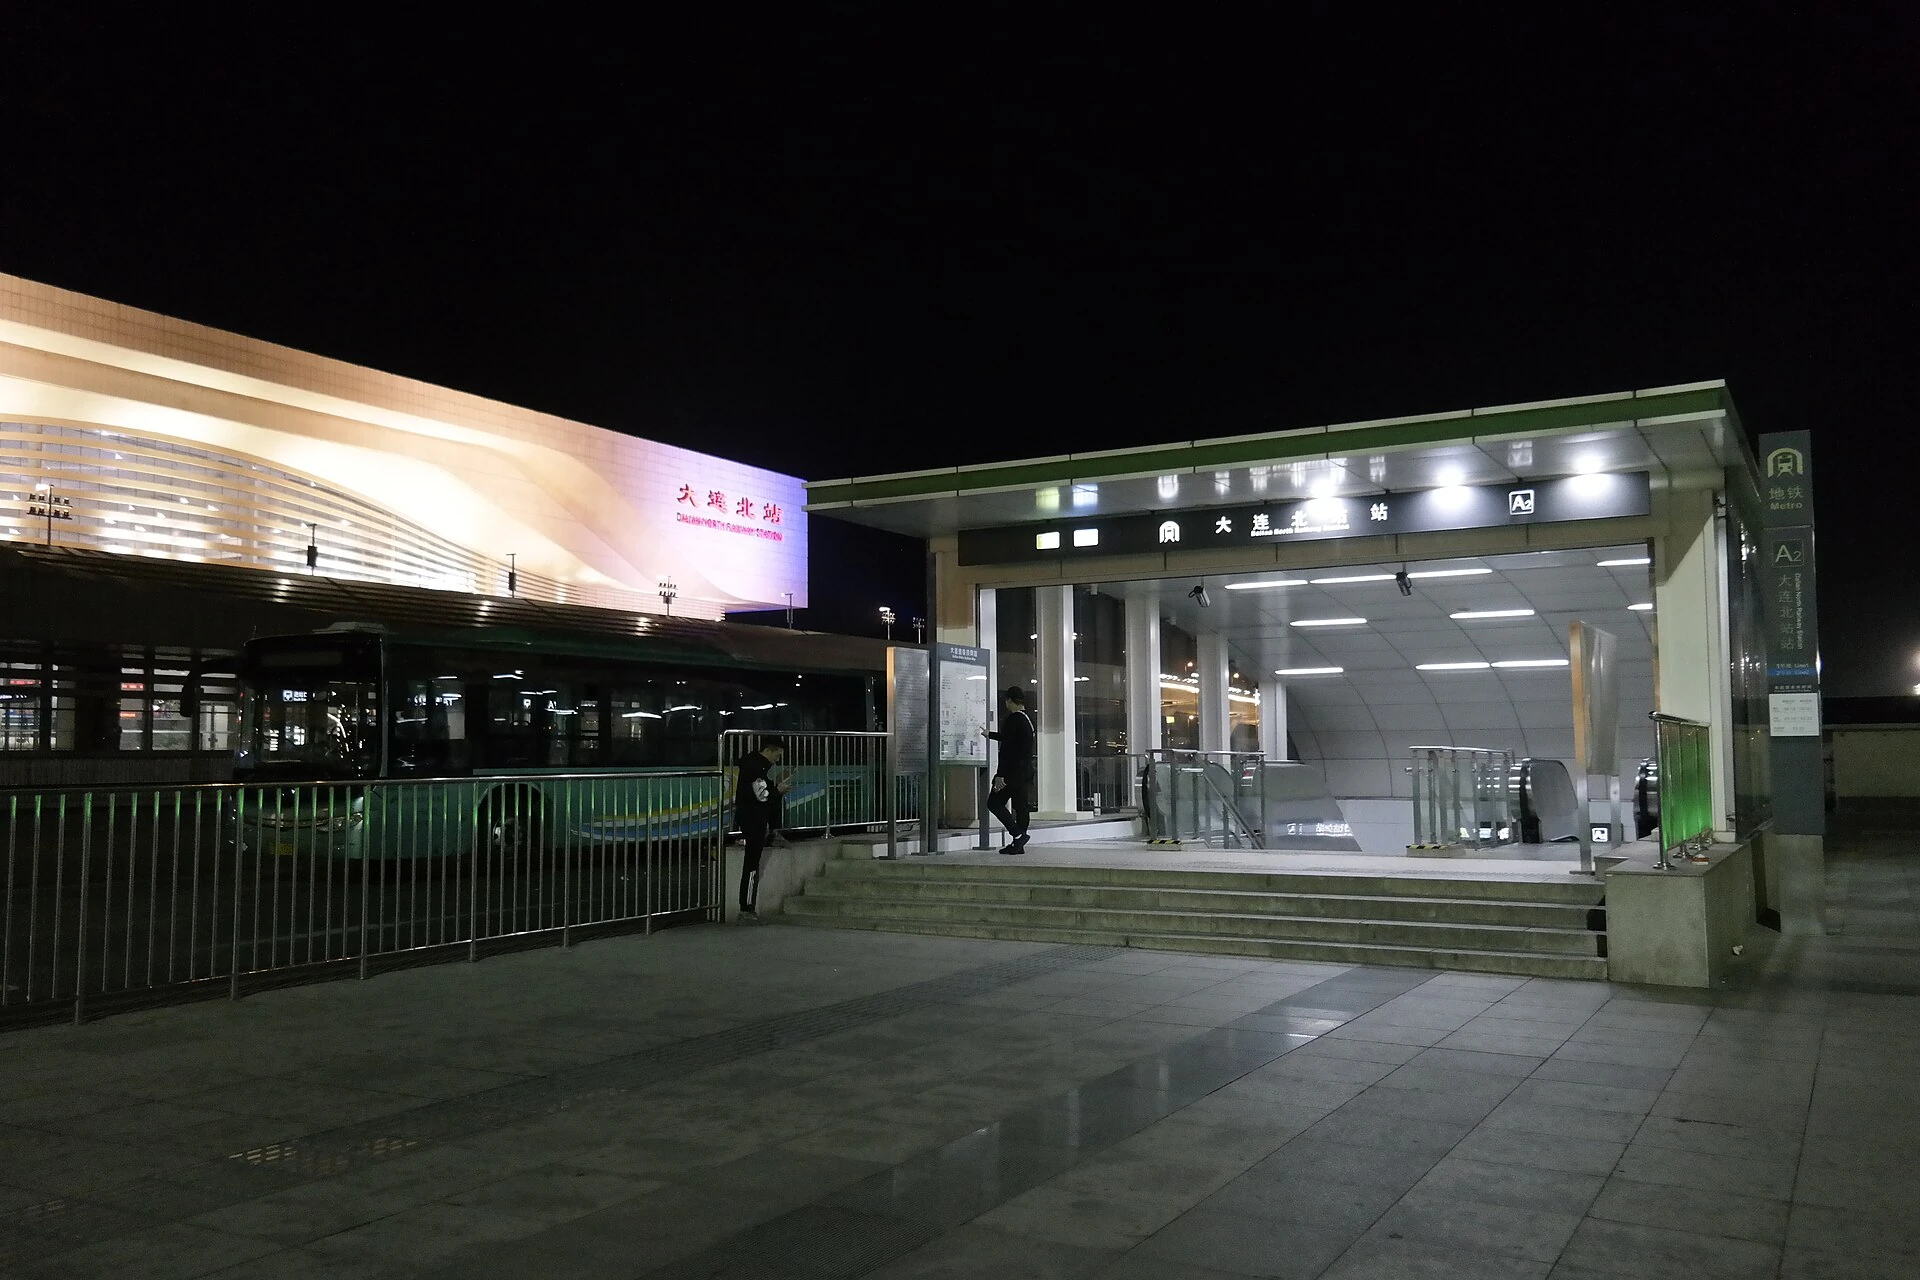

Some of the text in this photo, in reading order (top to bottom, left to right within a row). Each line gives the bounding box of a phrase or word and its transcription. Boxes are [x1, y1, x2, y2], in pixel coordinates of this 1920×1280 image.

[1511, 493, 1533, 512] A2
[1769, 486, 1804, 500] 地铁
[677, 484, 783, 524] 大连北站
[1770, 502, 1803, 511] Metro
[1215, 503, 1388, 533] 大连北站
[756, 528, 782, 541] STATION
[1775, 544, 1802, 563] A2
